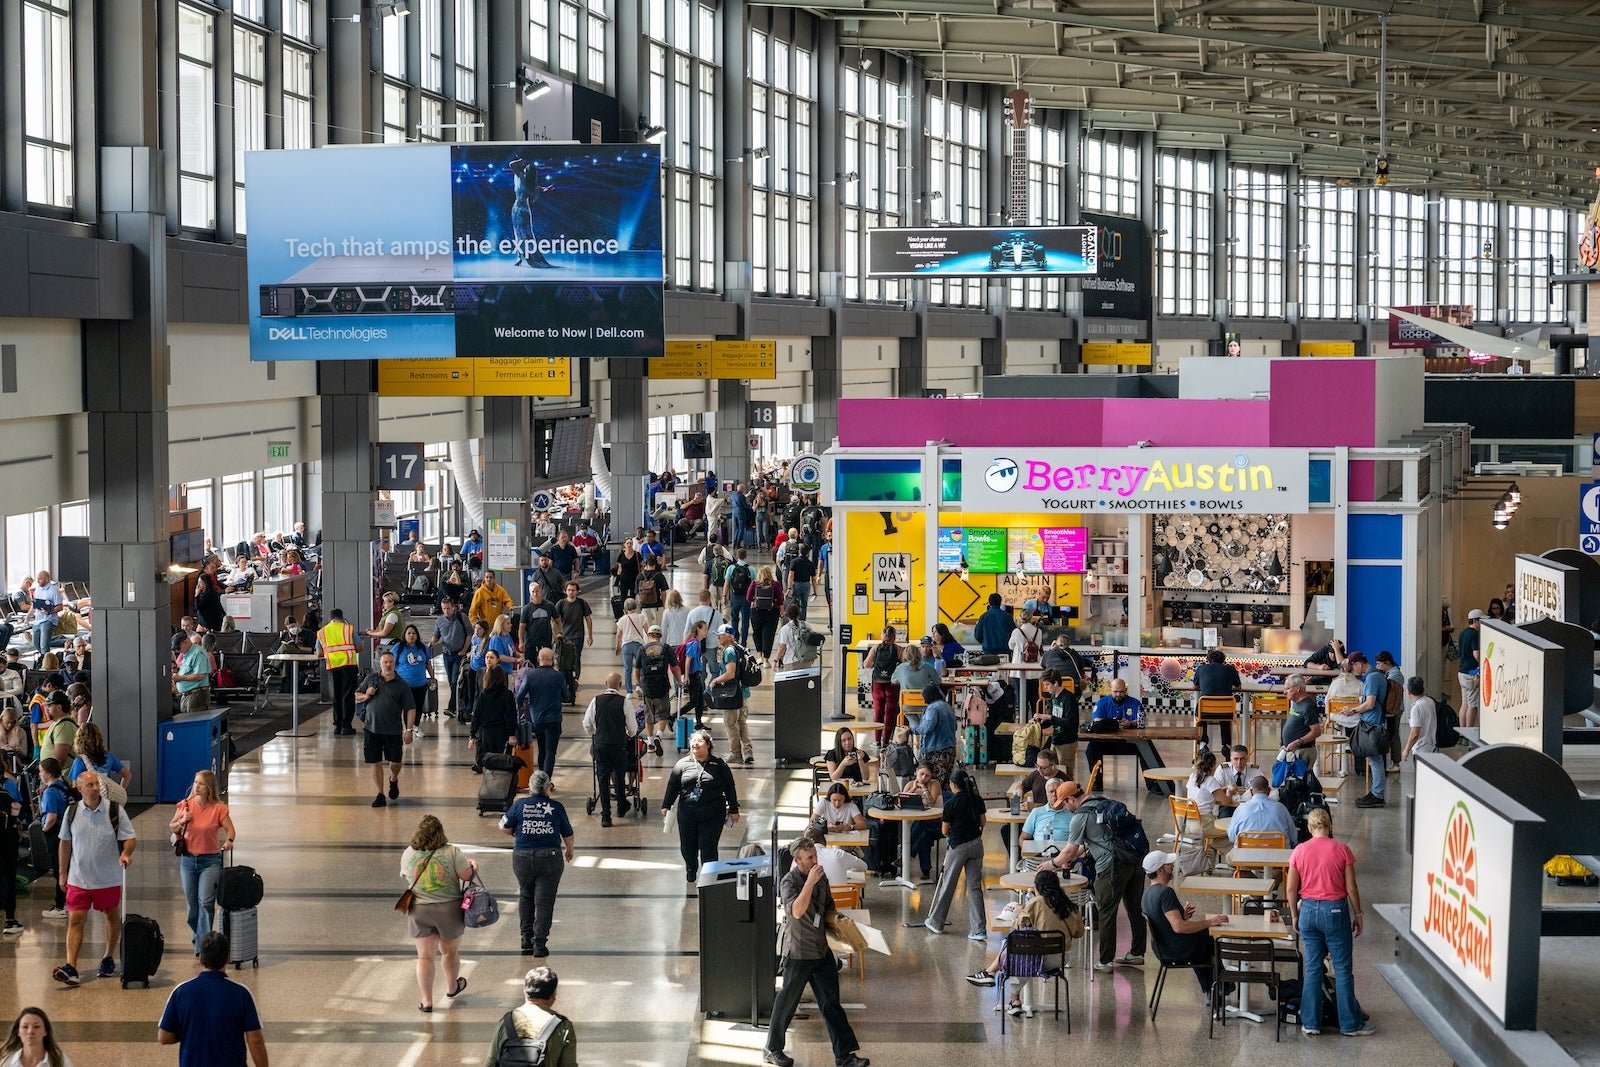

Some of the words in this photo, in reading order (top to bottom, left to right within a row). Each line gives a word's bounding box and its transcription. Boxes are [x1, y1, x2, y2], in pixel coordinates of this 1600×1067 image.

[284, 237, 338, 258] Tech
[342, 236, 384, 256] that
[390, 239, 450, 260] amps
[456, 235, 492, 255] the
[498, 236, 619, 260] experience
[411, 294, 445, 308] DELL
[494, 327, 546, 339] Welcome
[548, 327, 560, 339] to
[562, 327, 587, 339] Now
[596, 327, 645, 339] Dell.com
[489, 357, 521, 366] Baggage
[522, 356, 544, 364] Claim
[722, 352, 744, 360] Baggage
[409, 371, 449, 379] Restrooms
[495, 371, 528, 379] Terminal
[529, 371, 544, 379] Exit
[753, 407, 774, 423] 18
[272, 446, 290, 458] EXIT
[385, 453, 418, 479] 17
[1041, 498, 1095, 510] YOGURT
[1108, 499, 1187, 510] SMOOTHIES
[1199, 499, 1244, 510] BOWLS
[968, 534, 991, 543] Bowls
[1003, 574, 1050, 586] AUSTIN
[1523, 571, 1557, 611] HIPPIES
[1514, 713, 1540, 731] TORTILLA
[521, 820, 553, 828] PEOPLE
[521, 827, 555, 835] STRONG
